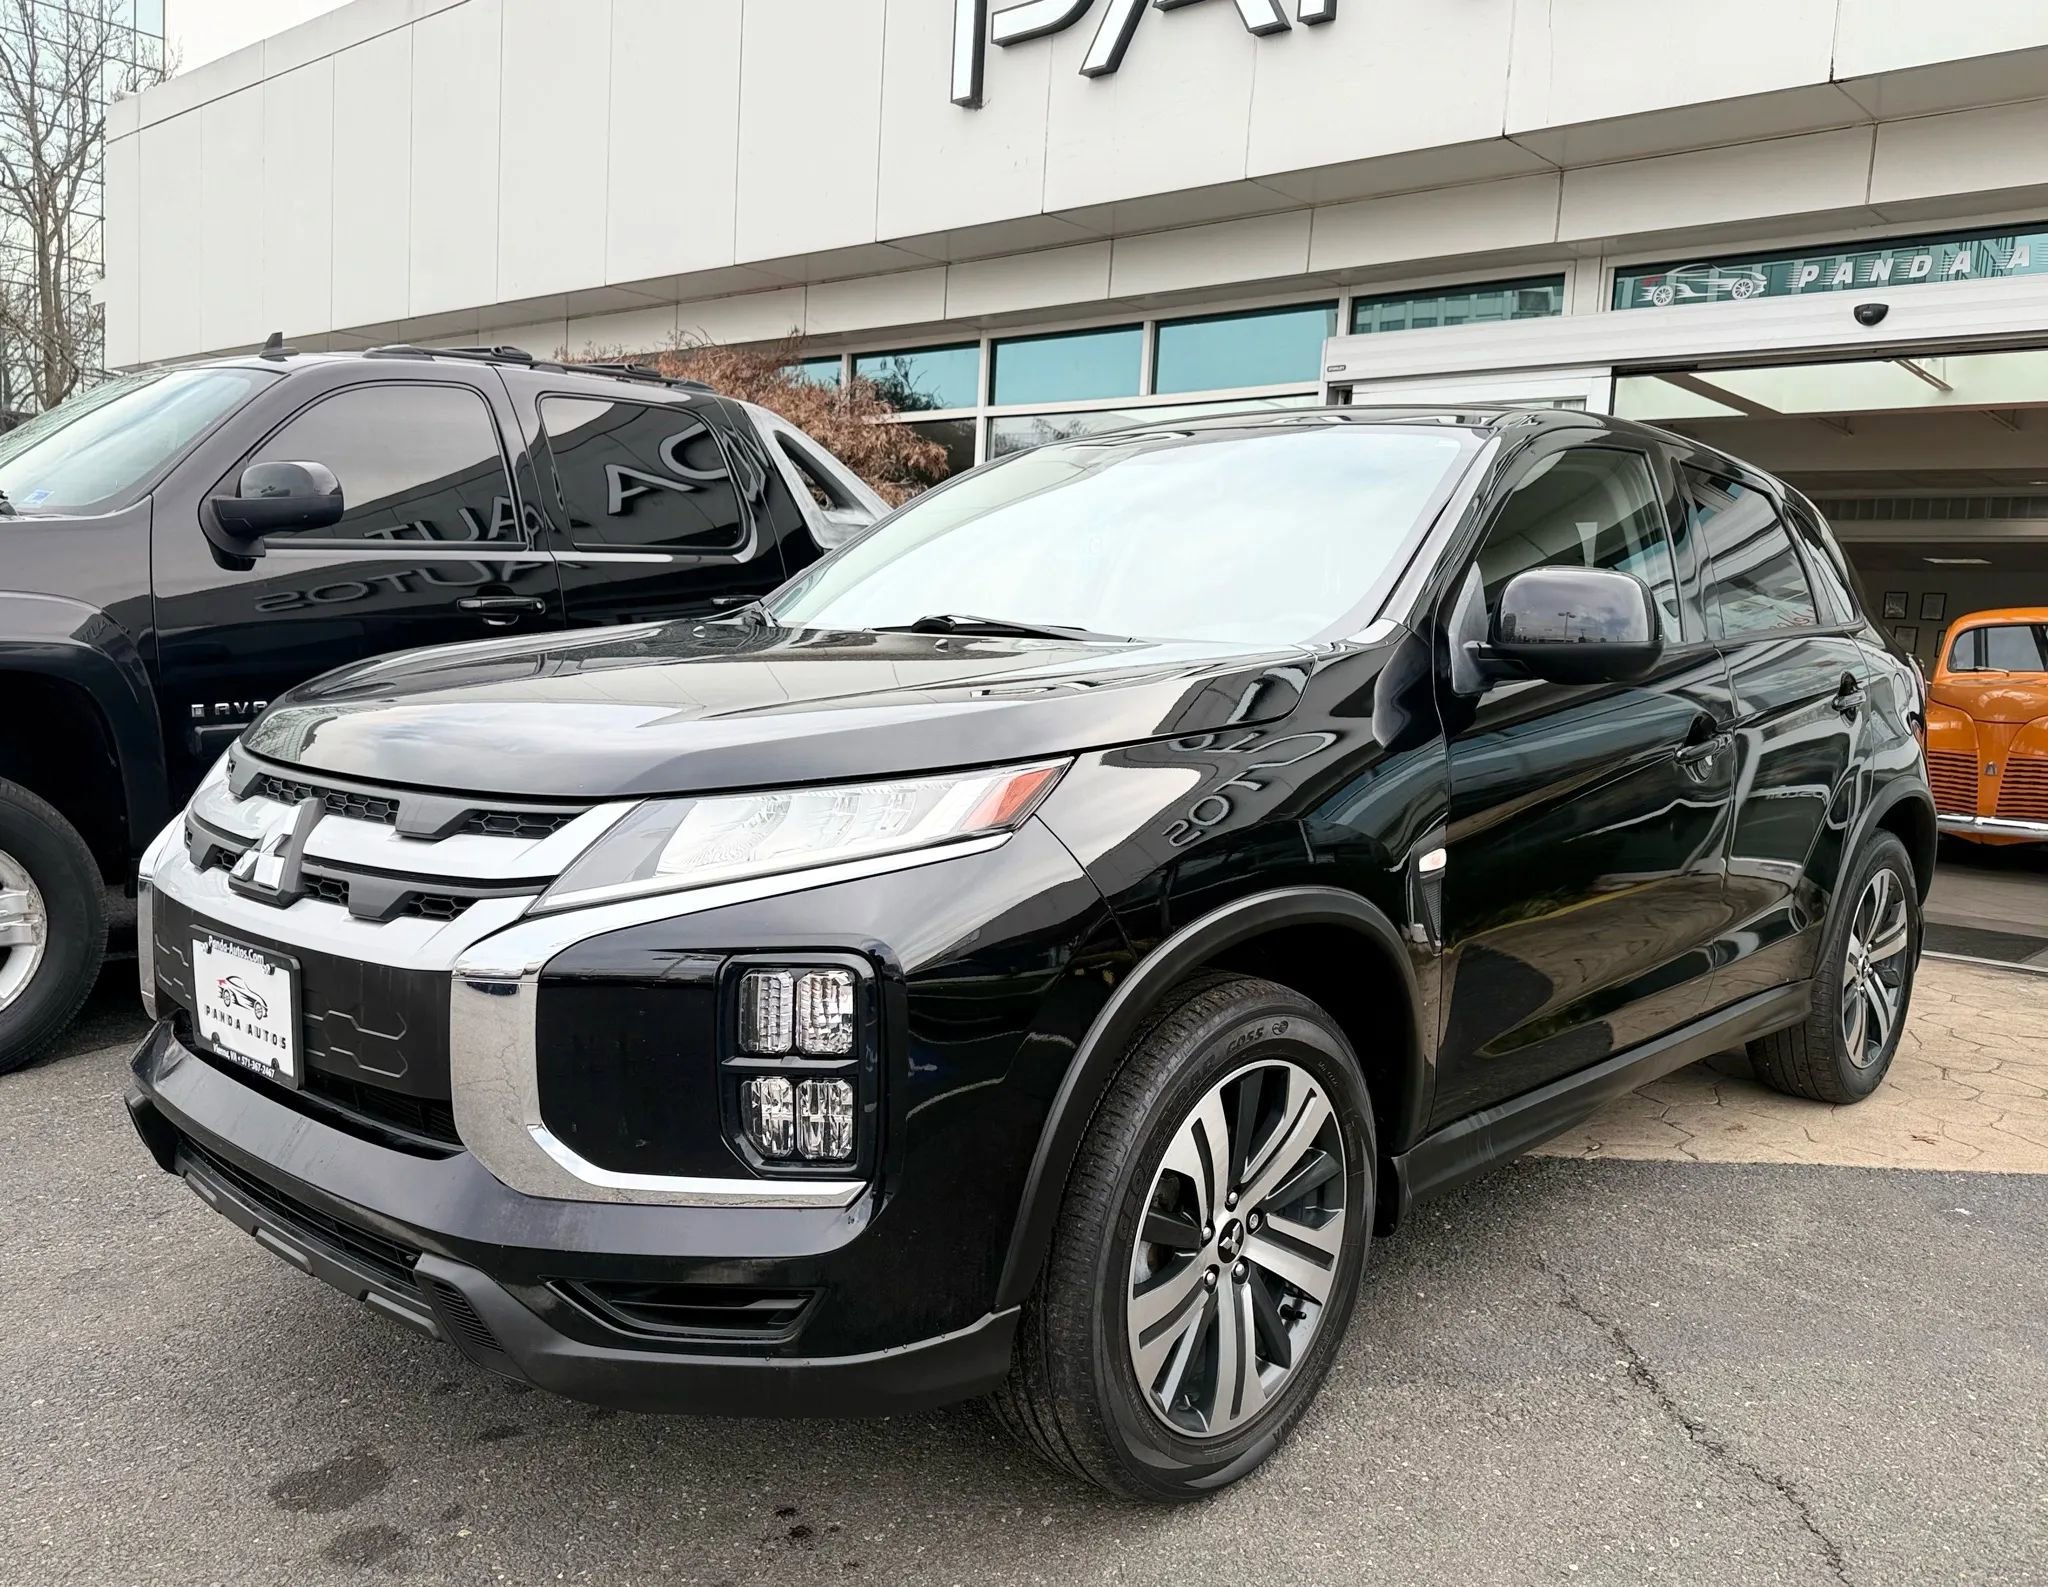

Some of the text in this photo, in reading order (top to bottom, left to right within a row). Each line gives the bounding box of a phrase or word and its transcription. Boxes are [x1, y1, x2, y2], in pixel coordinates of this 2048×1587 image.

[1797, 250, 1971, 288] PANDA
[206, 1004, 286, 1049] PANDA AUTOS
